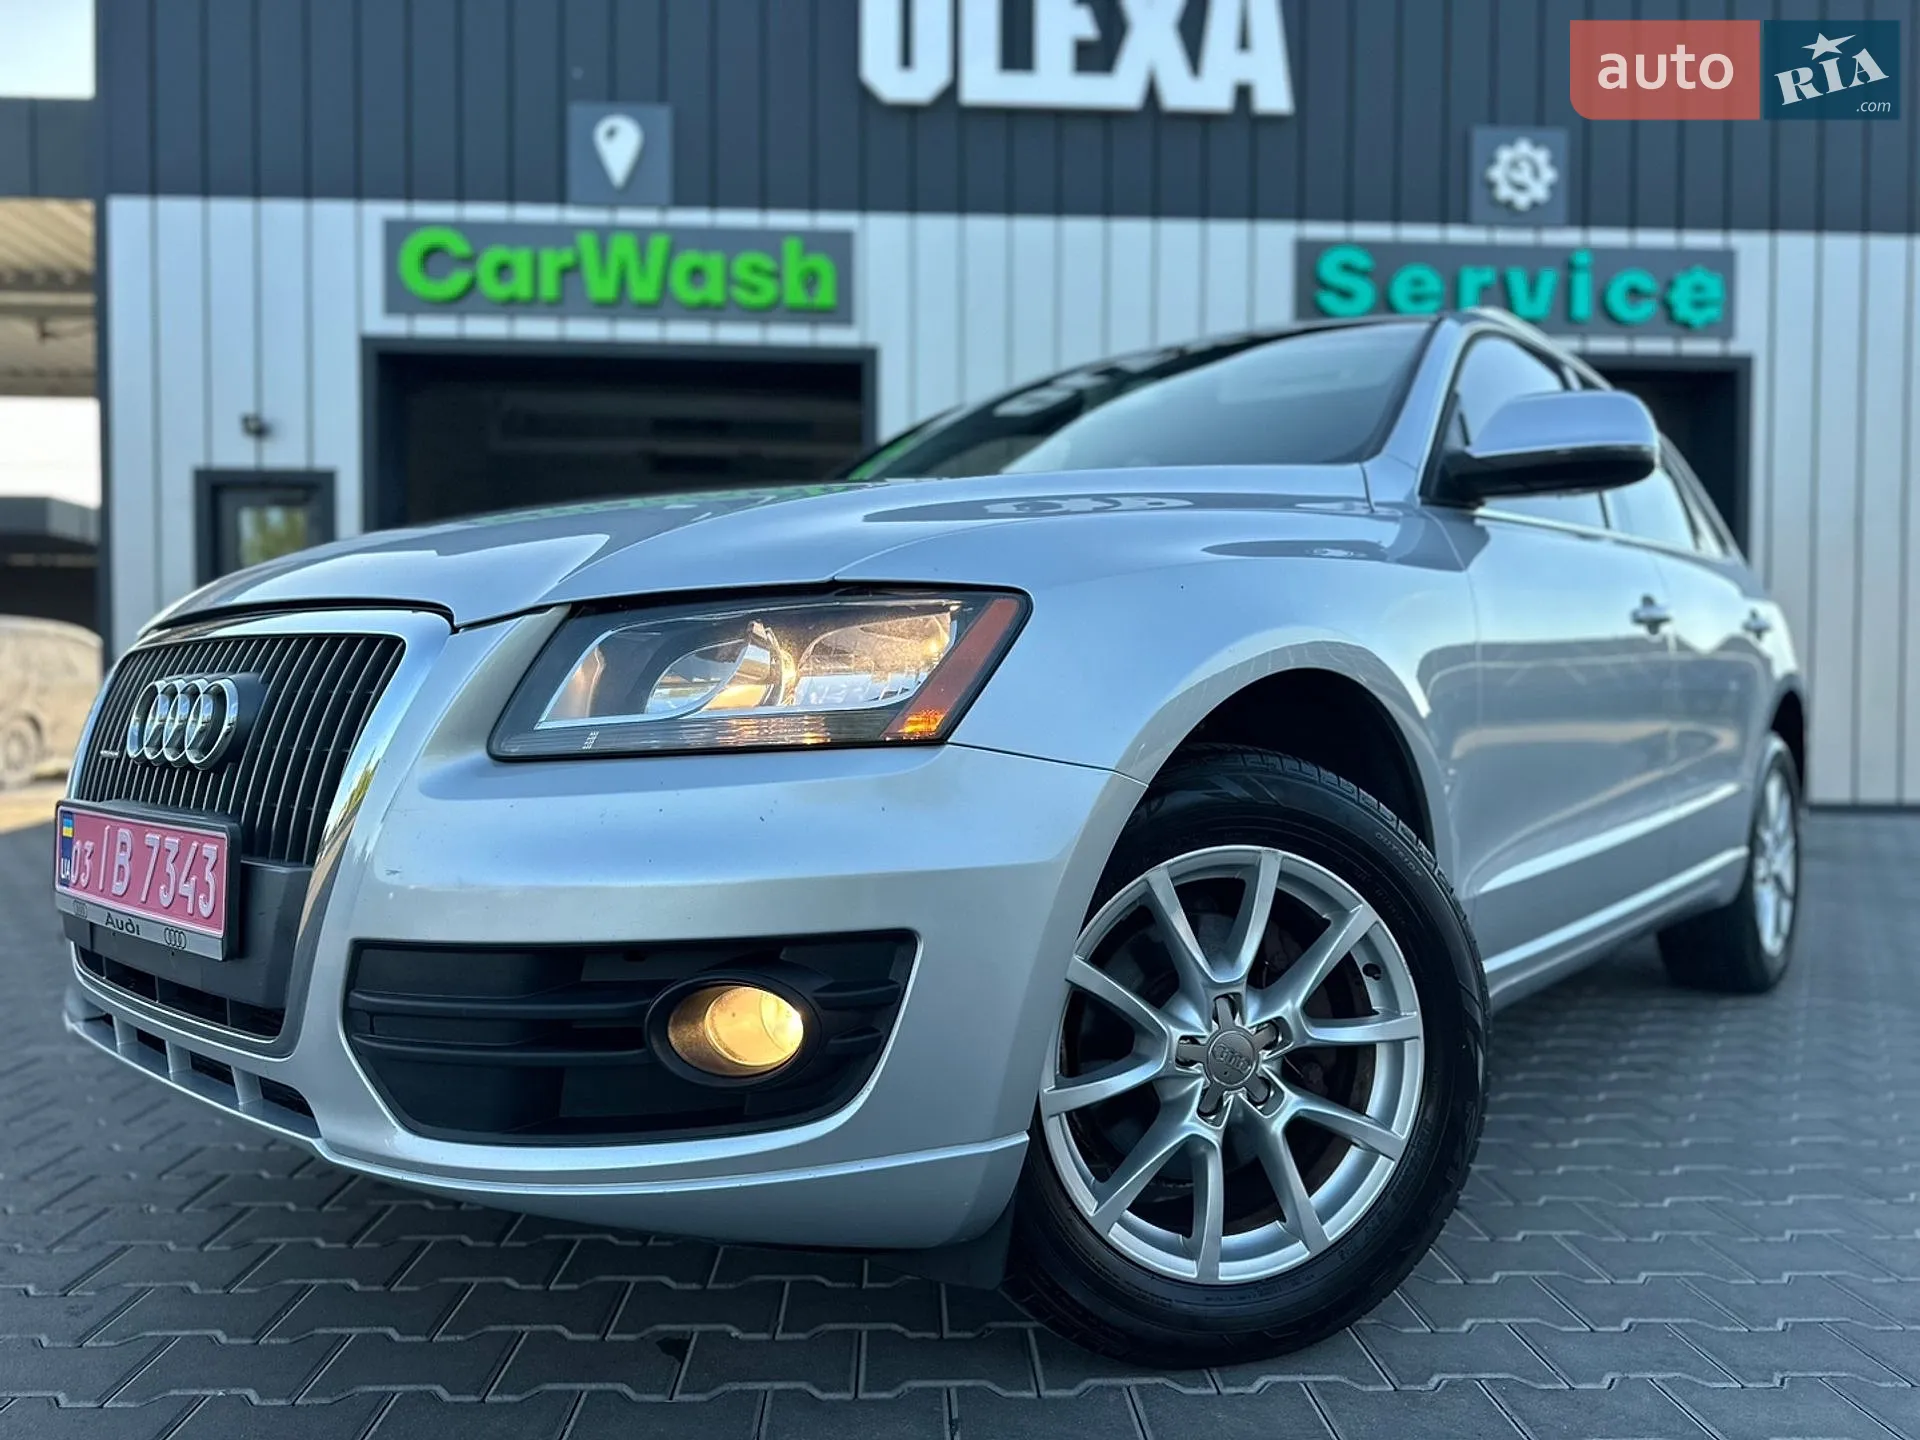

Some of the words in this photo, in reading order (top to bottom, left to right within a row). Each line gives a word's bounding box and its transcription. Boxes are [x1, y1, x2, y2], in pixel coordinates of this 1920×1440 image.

[397, 225, 837, 311] CarWash
[1314, 243, 1726, 329] Service
[71, 839, 95, 889] 03
[141, 833, 218, 918] 7343
[105, 912, 141, 936] Audi
